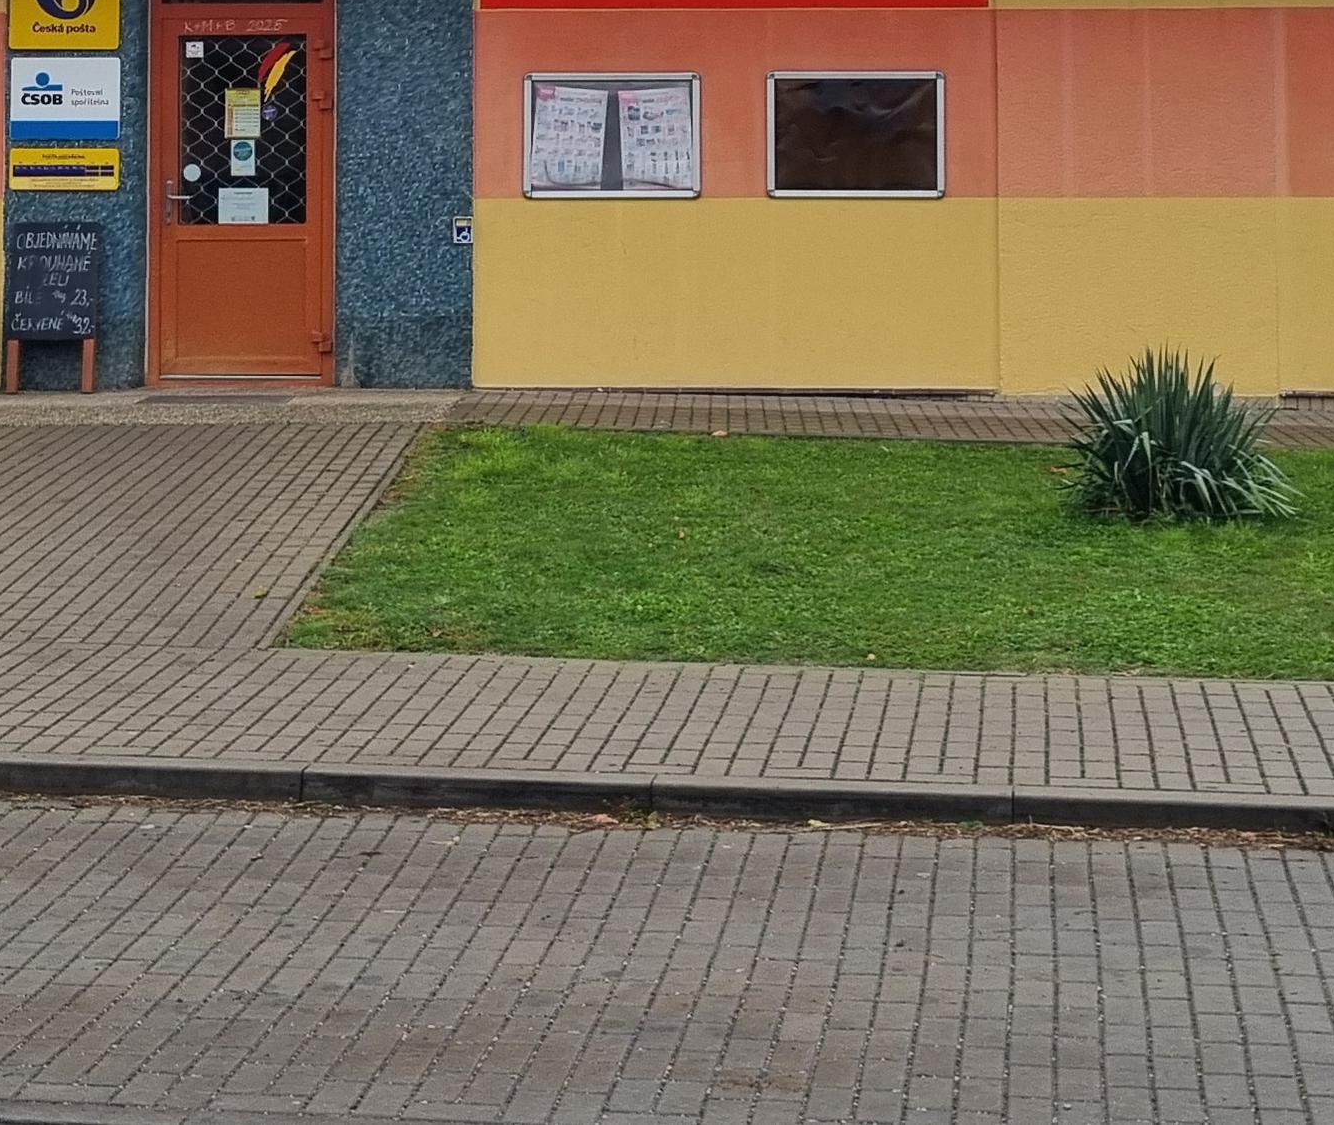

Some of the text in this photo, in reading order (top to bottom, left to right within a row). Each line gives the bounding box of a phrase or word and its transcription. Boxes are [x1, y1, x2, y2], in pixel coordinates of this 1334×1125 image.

[32, 21, 96, 35] Česká pošta
[246, 19, 288, 32] 2025
[21, 92, 63, 105] ČSOB
[16, 224, 97, 251] OBJEDNÁVÁME
